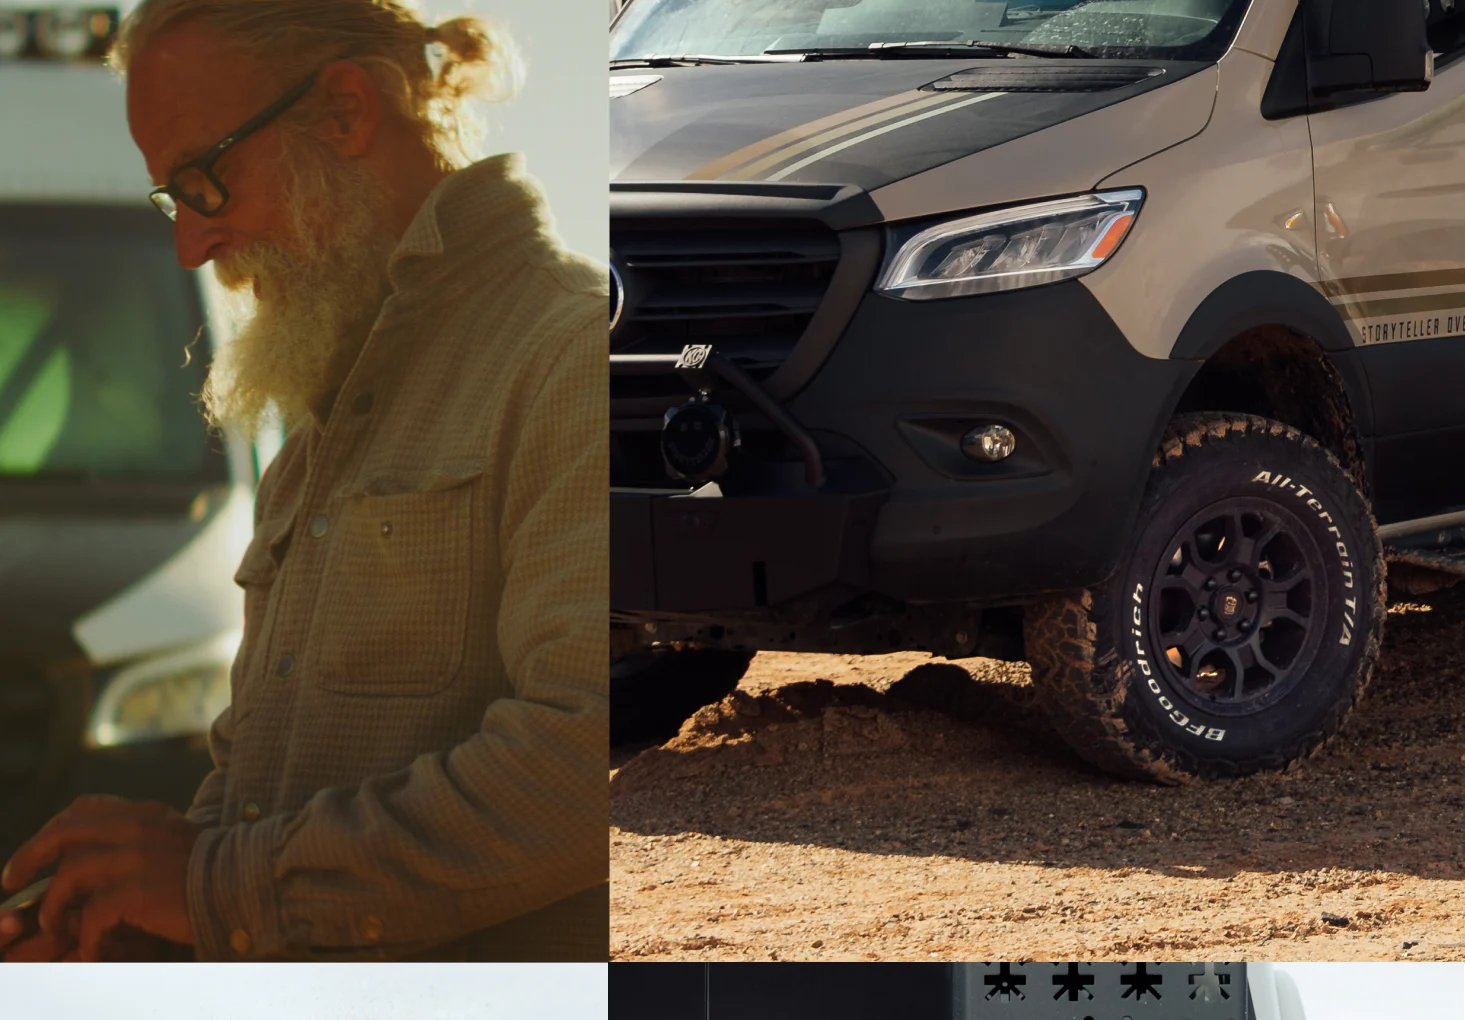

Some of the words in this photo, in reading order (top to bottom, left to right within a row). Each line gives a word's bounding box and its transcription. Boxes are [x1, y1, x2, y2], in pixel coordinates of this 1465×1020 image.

[1361, 318, 1440, 344] STORYTELLER
[1252, 470, 1354, 589] All-Terrain
[1338, 596, 1356, 646] T/A
[1131, 583, 1226, 742] BFGoodrich
